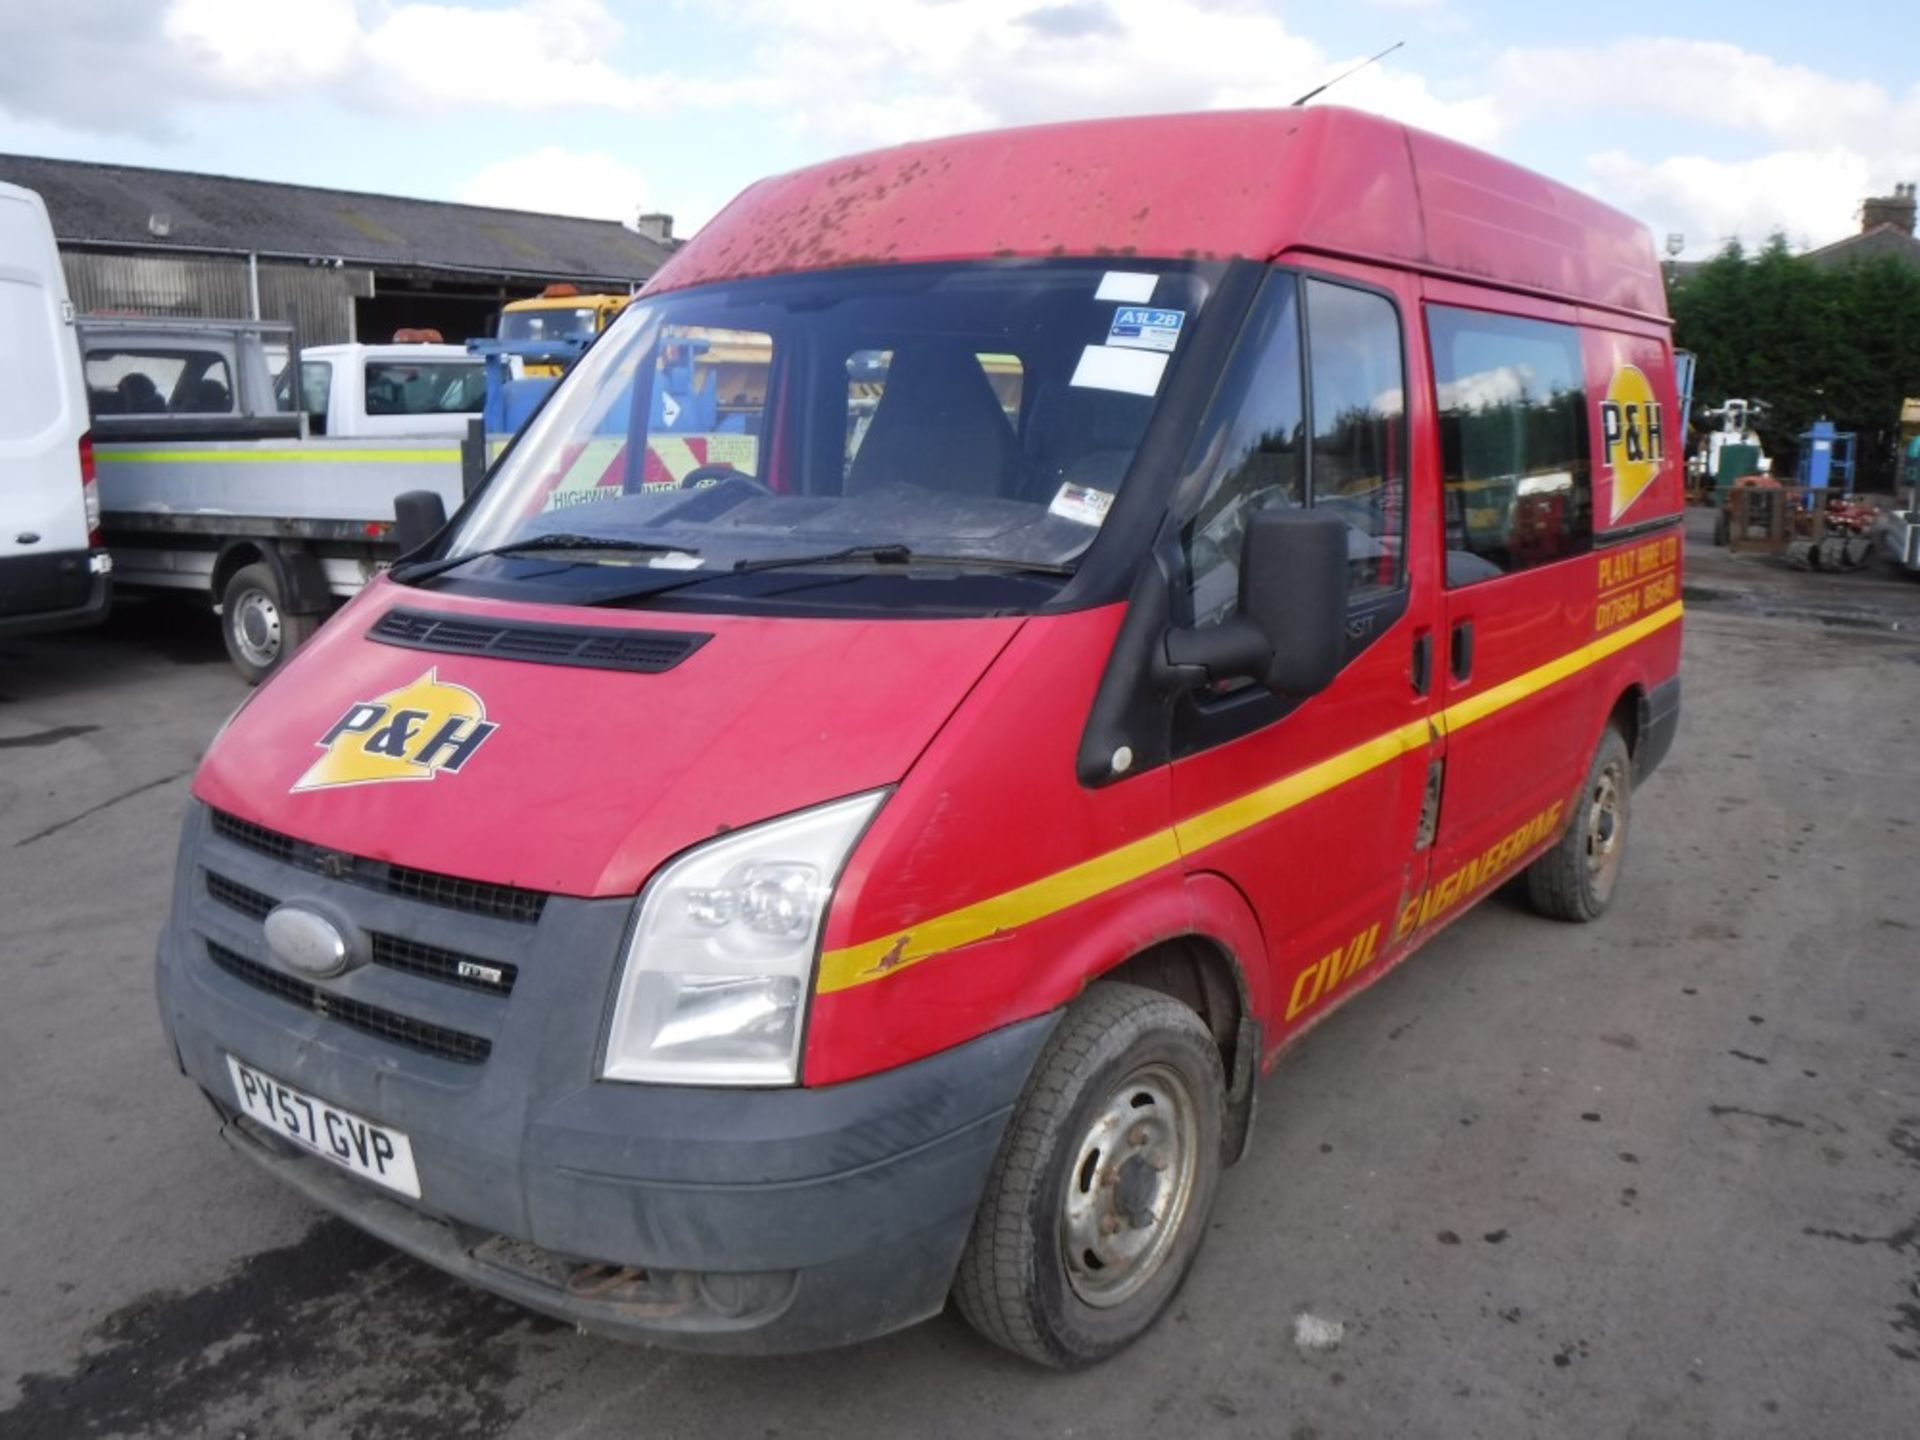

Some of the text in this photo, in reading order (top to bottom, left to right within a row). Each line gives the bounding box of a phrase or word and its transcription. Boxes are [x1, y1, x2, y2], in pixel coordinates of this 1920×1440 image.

[1600, 402, 1663, 467] P&H
[316, 702, 499, 771] P&H
[1285, 922, 1381, 1022] CIVIL
[239, 1066, 317, 1143] PY57
[324, 1110, 395, 1174] GVP
